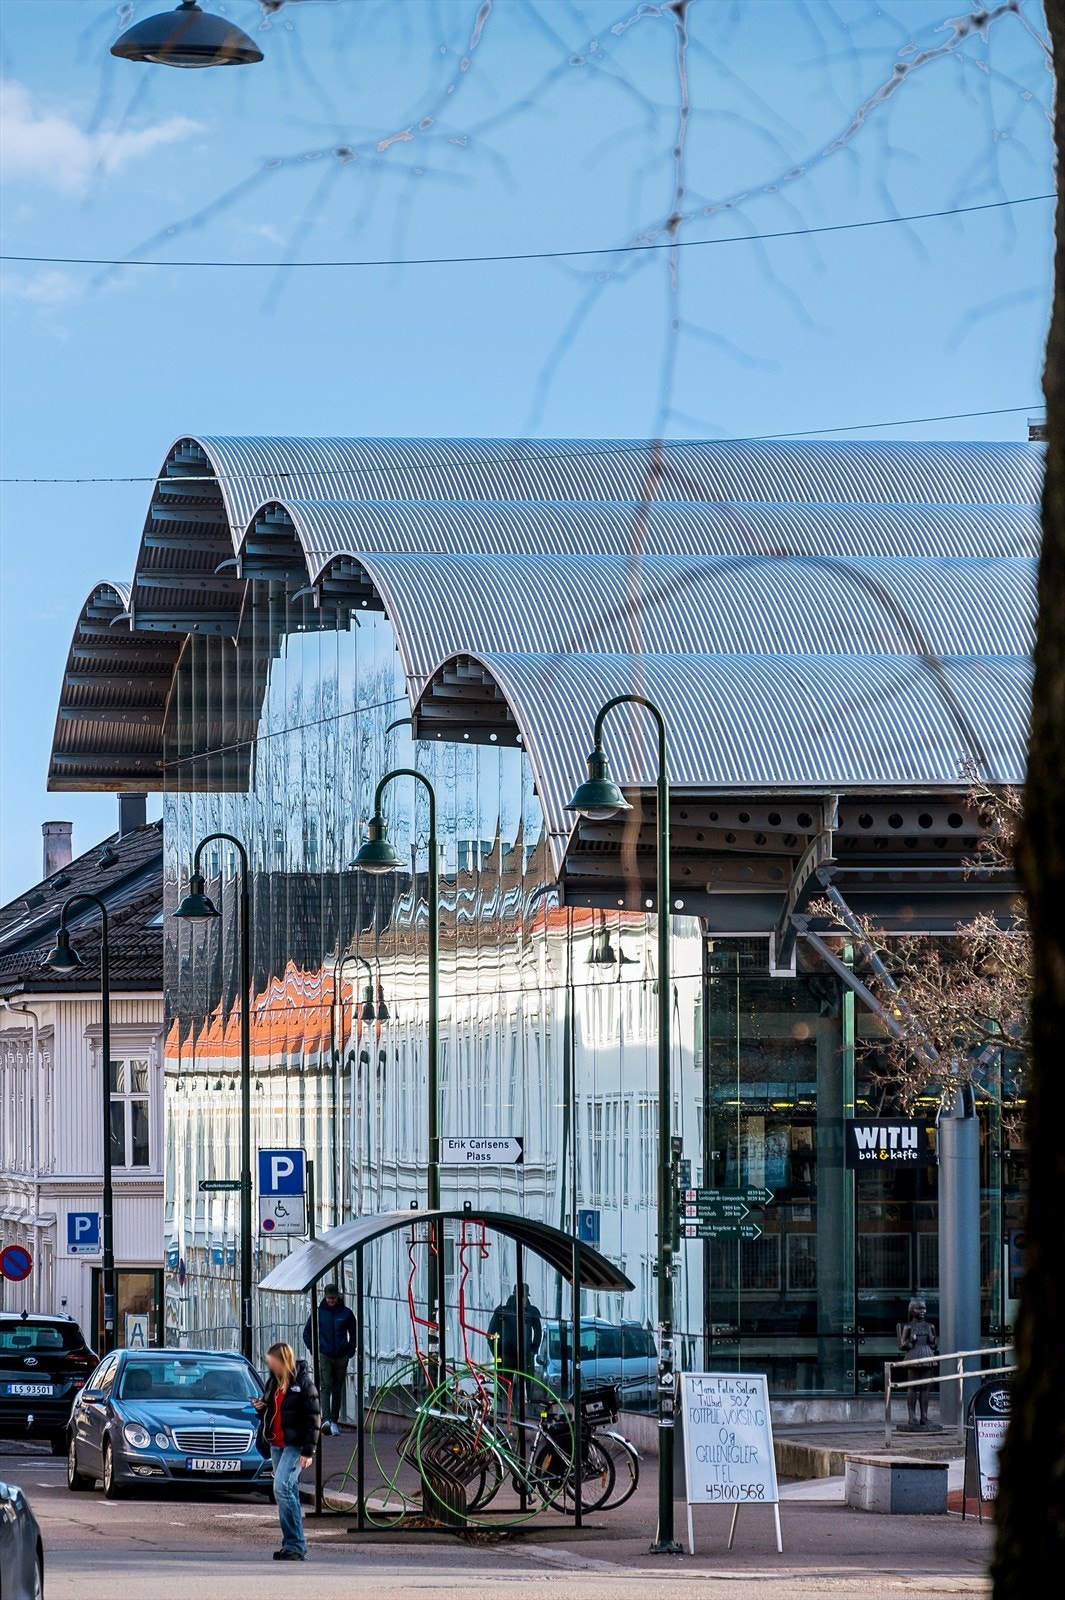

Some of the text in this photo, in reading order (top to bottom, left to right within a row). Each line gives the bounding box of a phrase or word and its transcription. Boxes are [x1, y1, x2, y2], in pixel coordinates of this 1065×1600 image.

[448, 1140, 509, 1149] Erik Carlsens
[854, 1127, 918, 1149] WITH
[466, 1151, 492, 1161] Plass
[859, 1149, 918, 1160] bok & kaffe
[271, 1156, 295, 1190] P
[75, 1216, 92, 1240] P
[14, 1385, 50, 1394] LS 93501
[735, 1381, 758, 1395] Salon
[977, 1420, 1008, 1428] Herrekli
[719, 1427, 736, 1446] Og
[210, 1460, 238, 1470] 28757
[712, 1464, 734, 1483] TEL
[705, 1483, 765, 1501] 45100568
